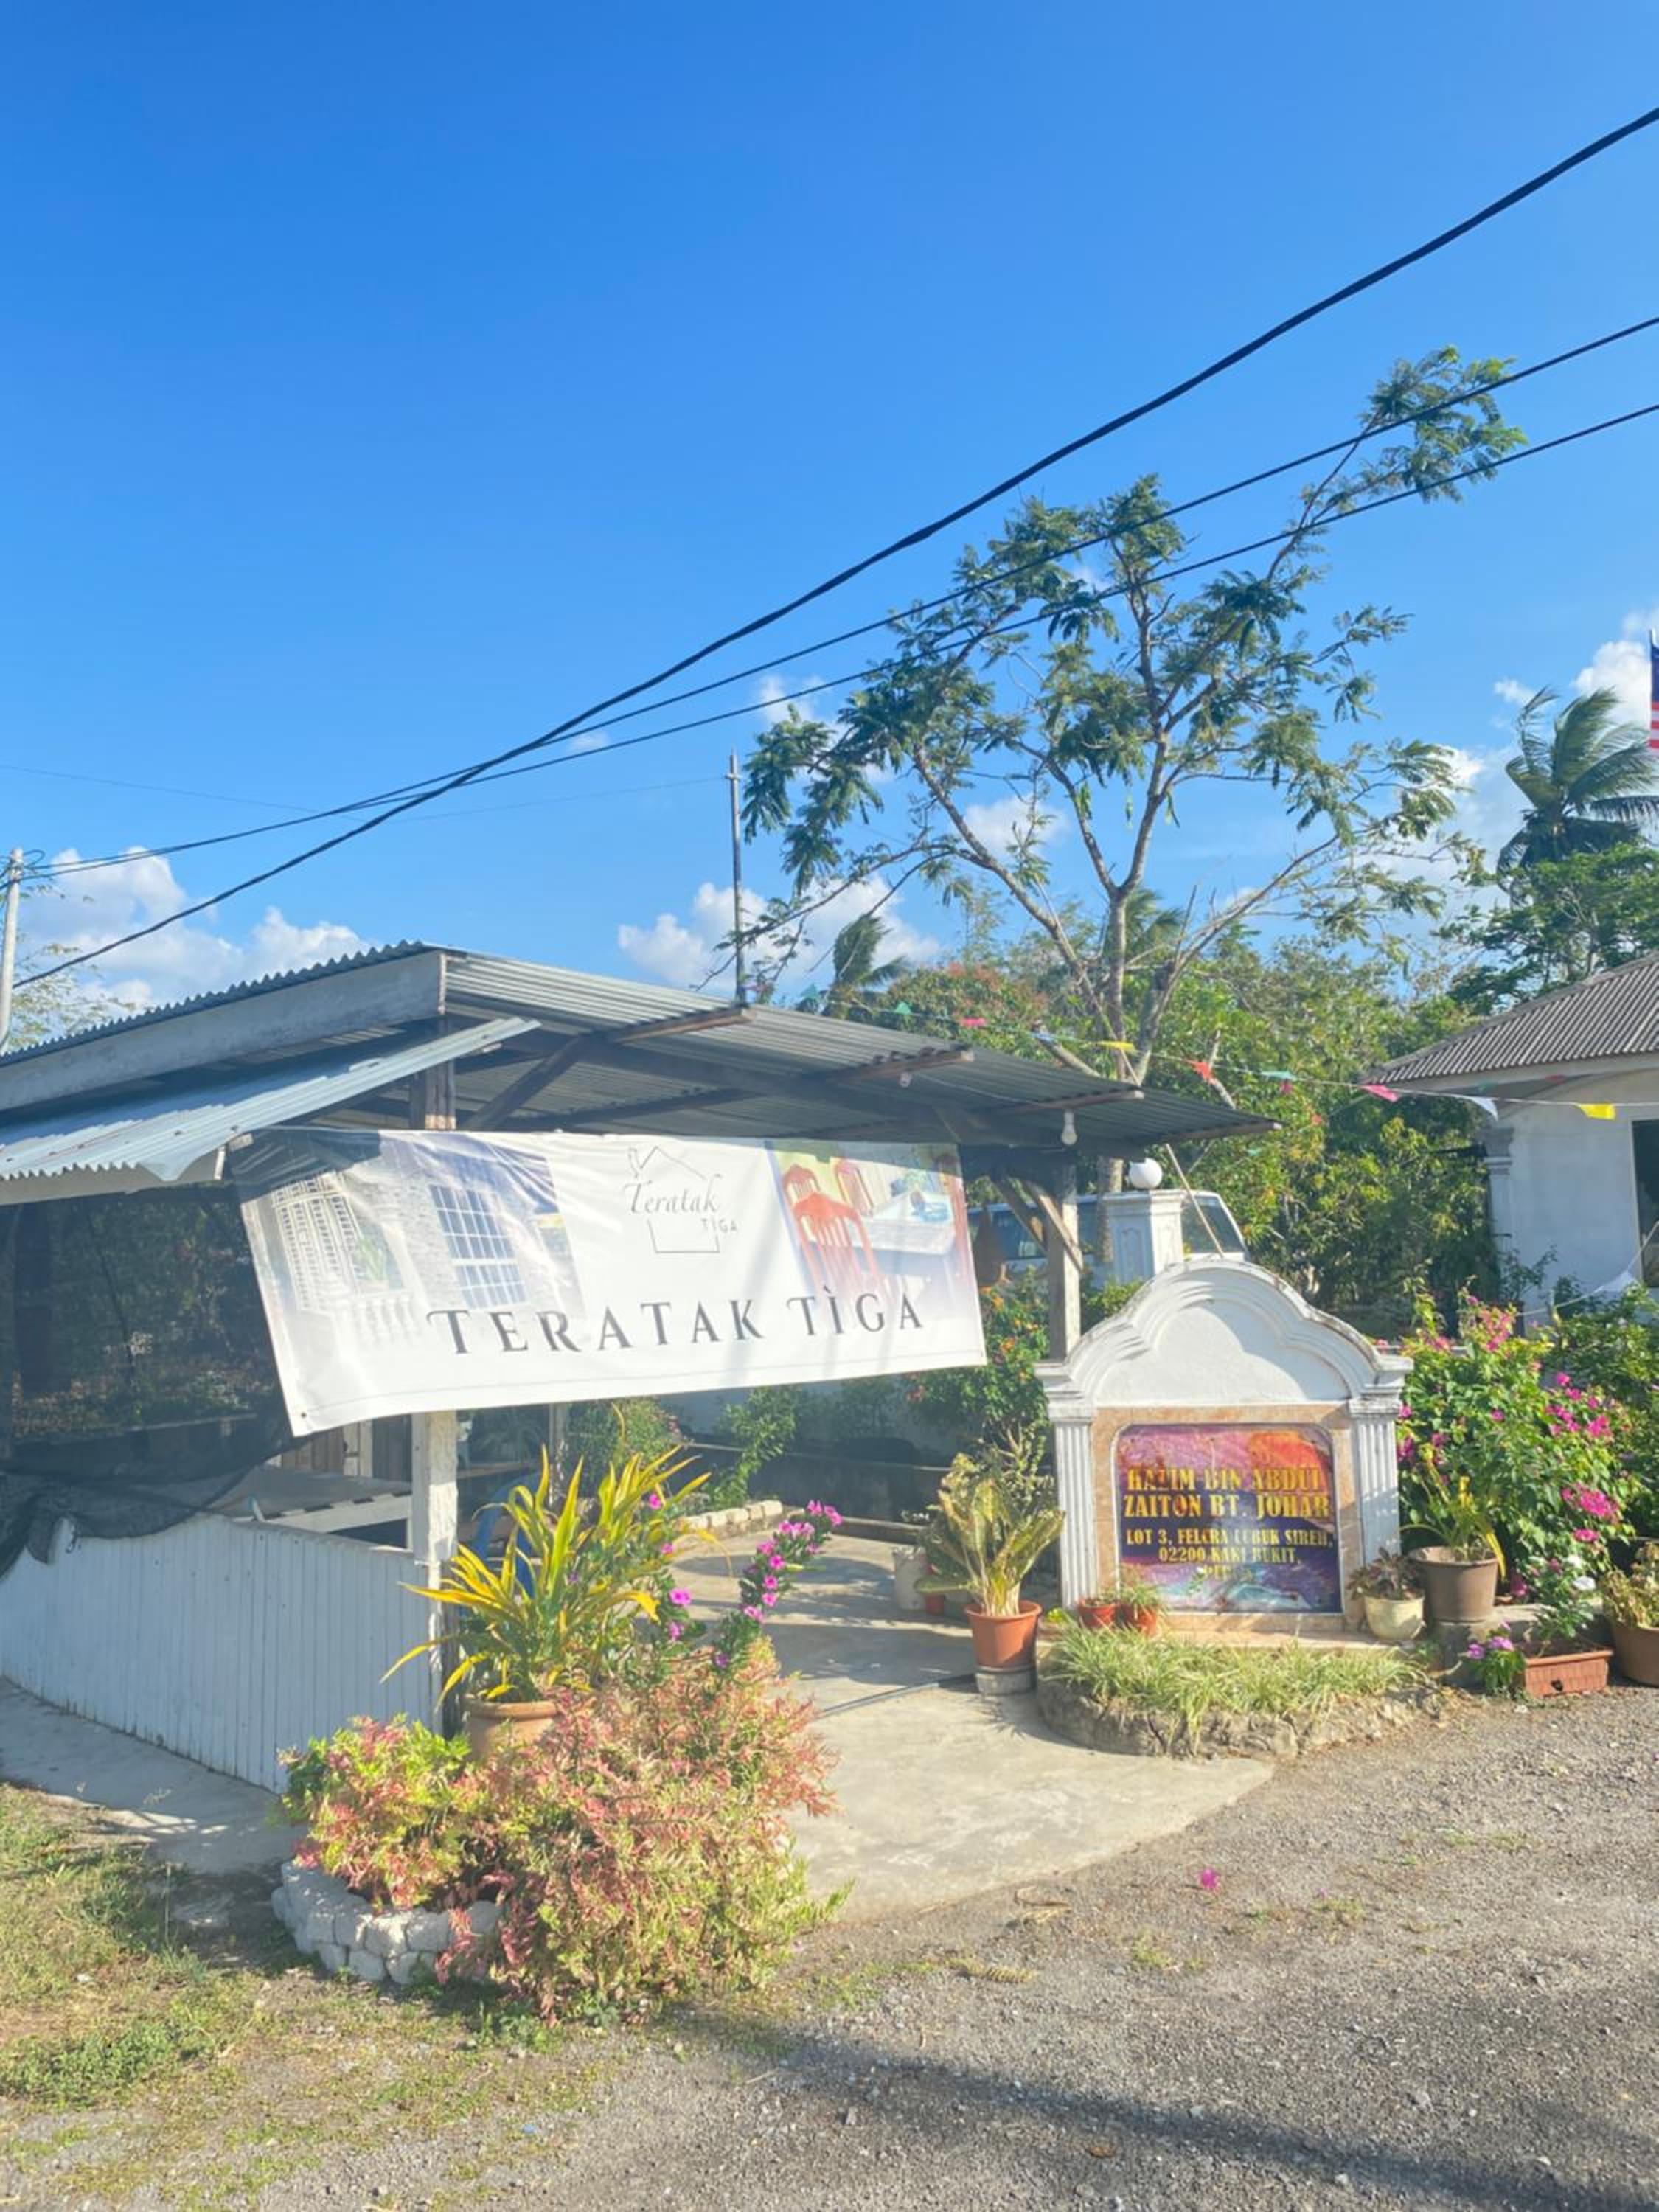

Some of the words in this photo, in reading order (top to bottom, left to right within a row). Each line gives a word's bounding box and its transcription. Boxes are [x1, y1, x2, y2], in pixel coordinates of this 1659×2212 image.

[625, 1172, 723, 1214] Teratak
[426, 1298, 764, 1355] TERATAK
[1124, 1494, 1203, 1517] ZAITON
[1256, 1493, 1330, 1520] JOHAR
[1126, 1528, 1153, 1545] LOT
[1158, 1546, 1206, 1562] 02200
